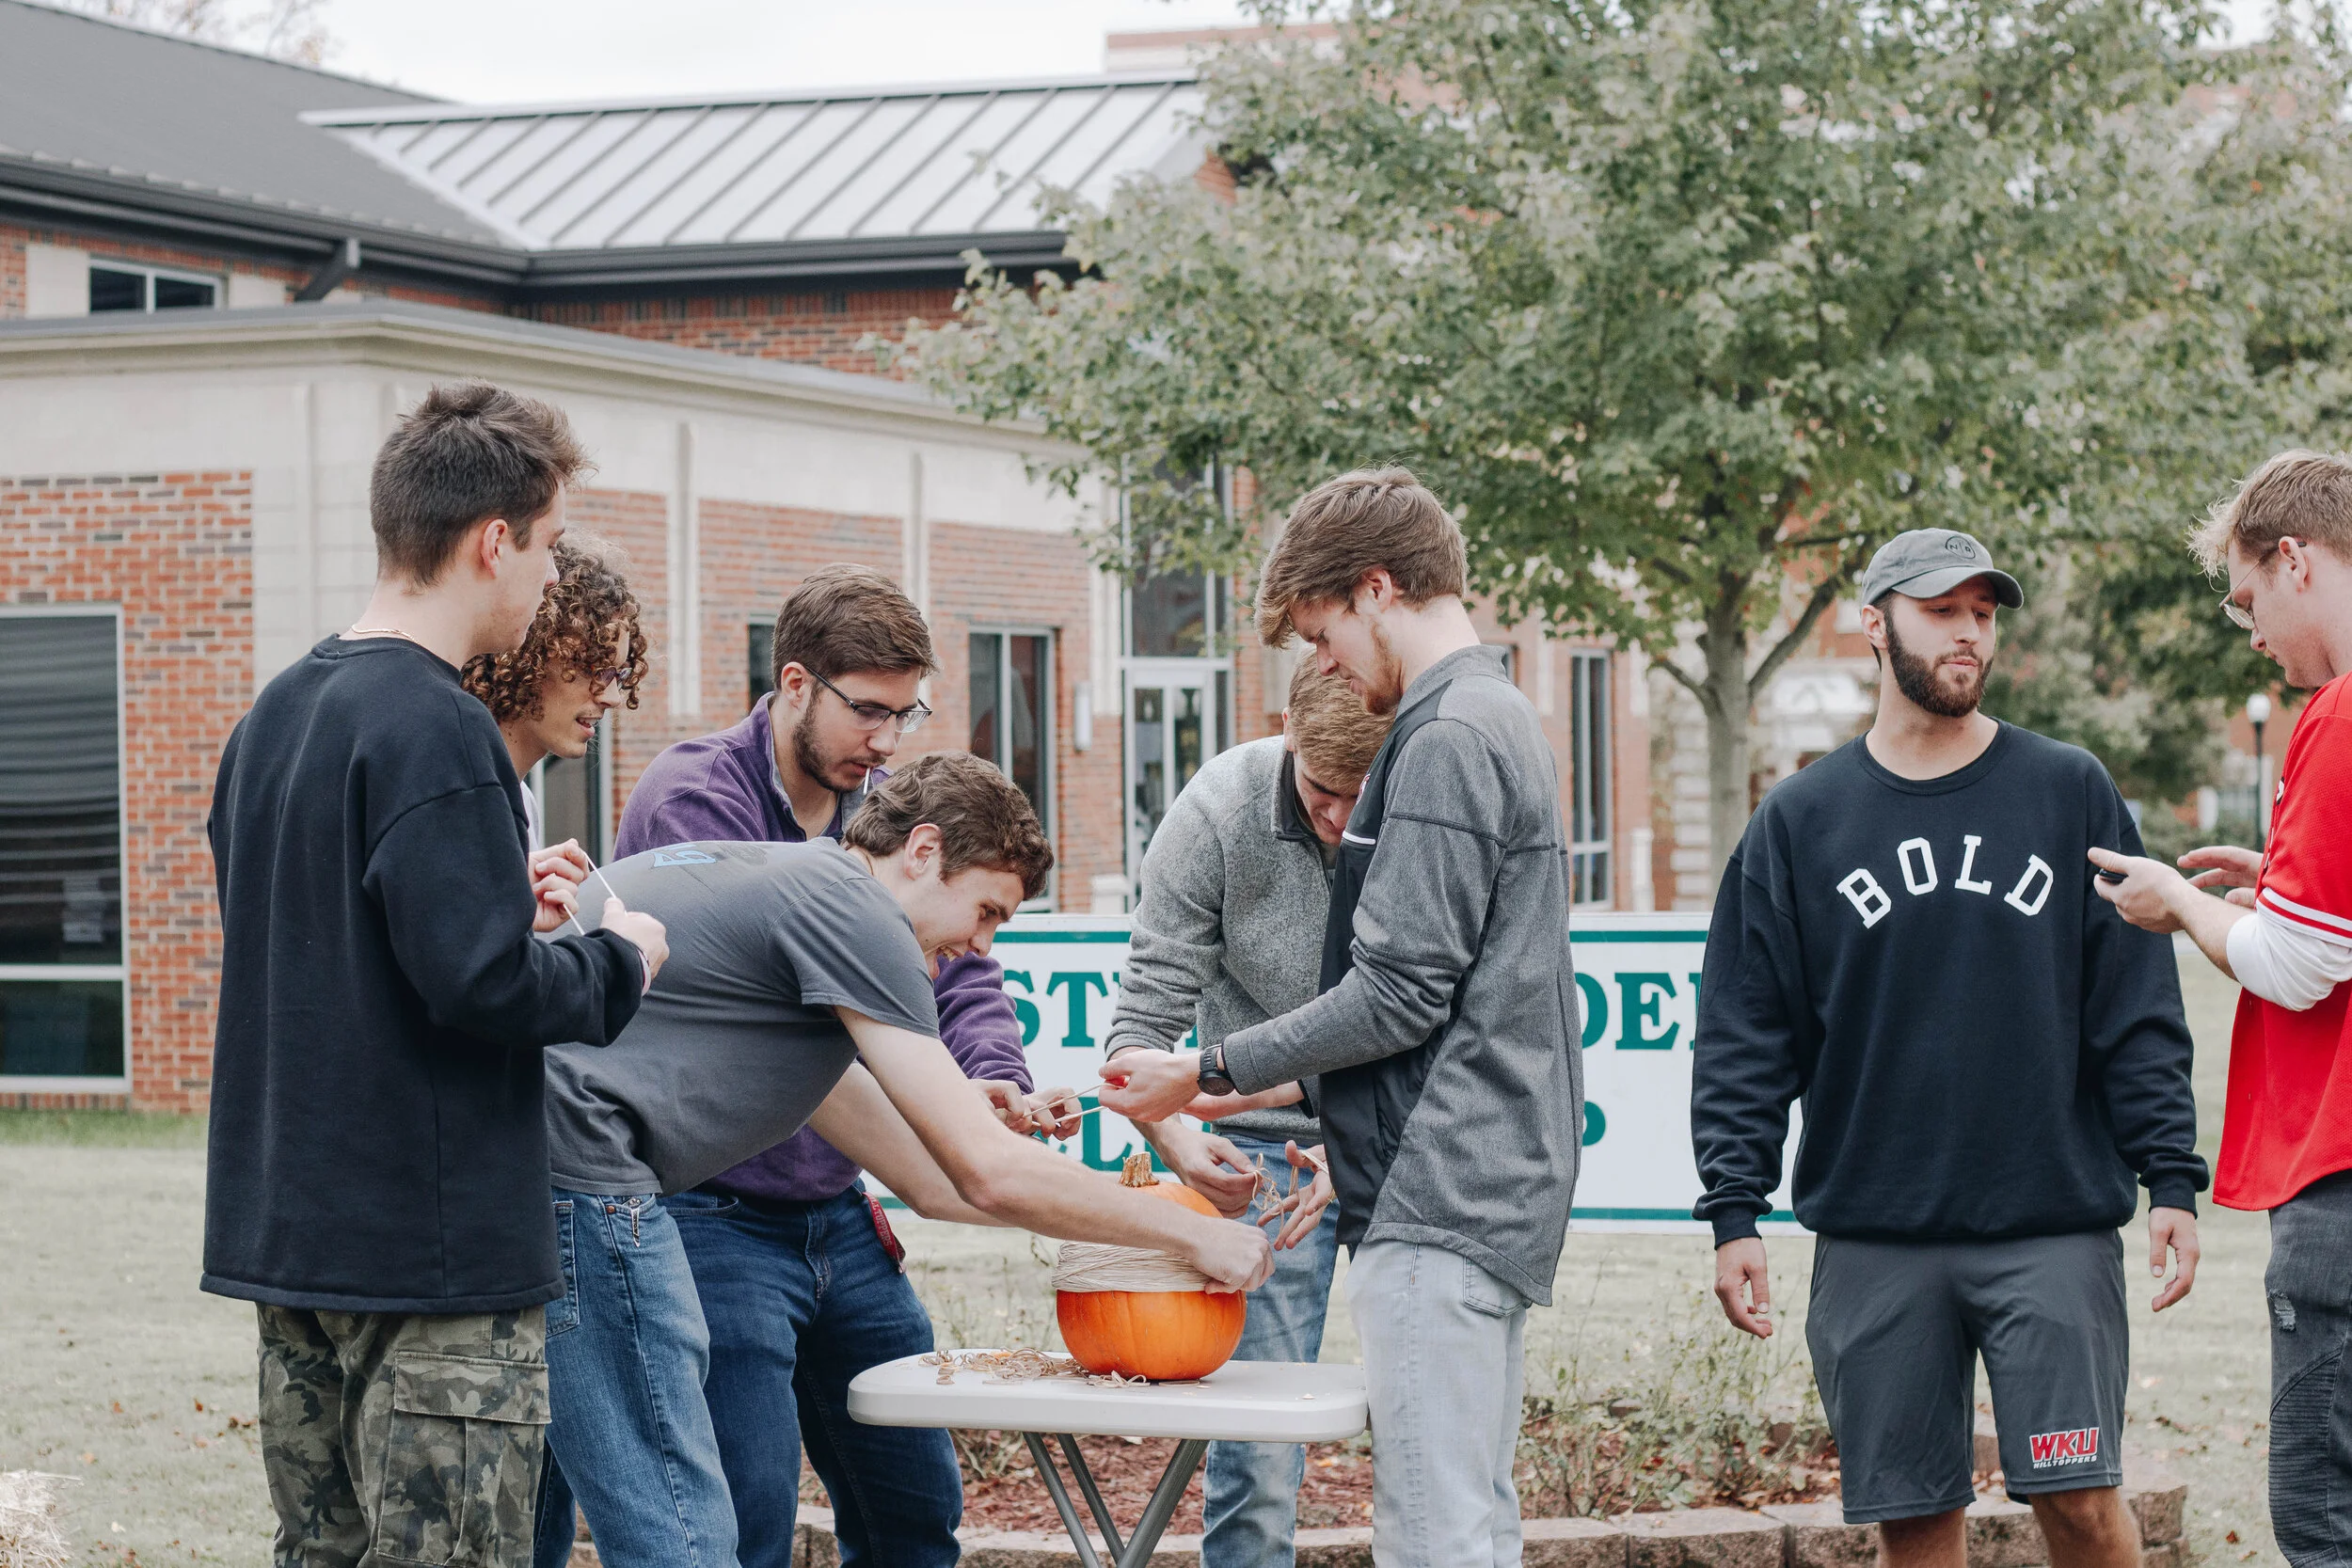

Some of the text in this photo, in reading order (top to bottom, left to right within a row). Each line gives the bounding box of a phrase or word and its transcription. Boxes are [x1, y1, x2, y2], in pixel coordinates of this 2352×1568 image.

[1836, 834, 2054, 929] BOLD
[2029, 1427, 2100, 1463] WKU
[2033, 1455, 2098, 1469] HILLTOPPERS
